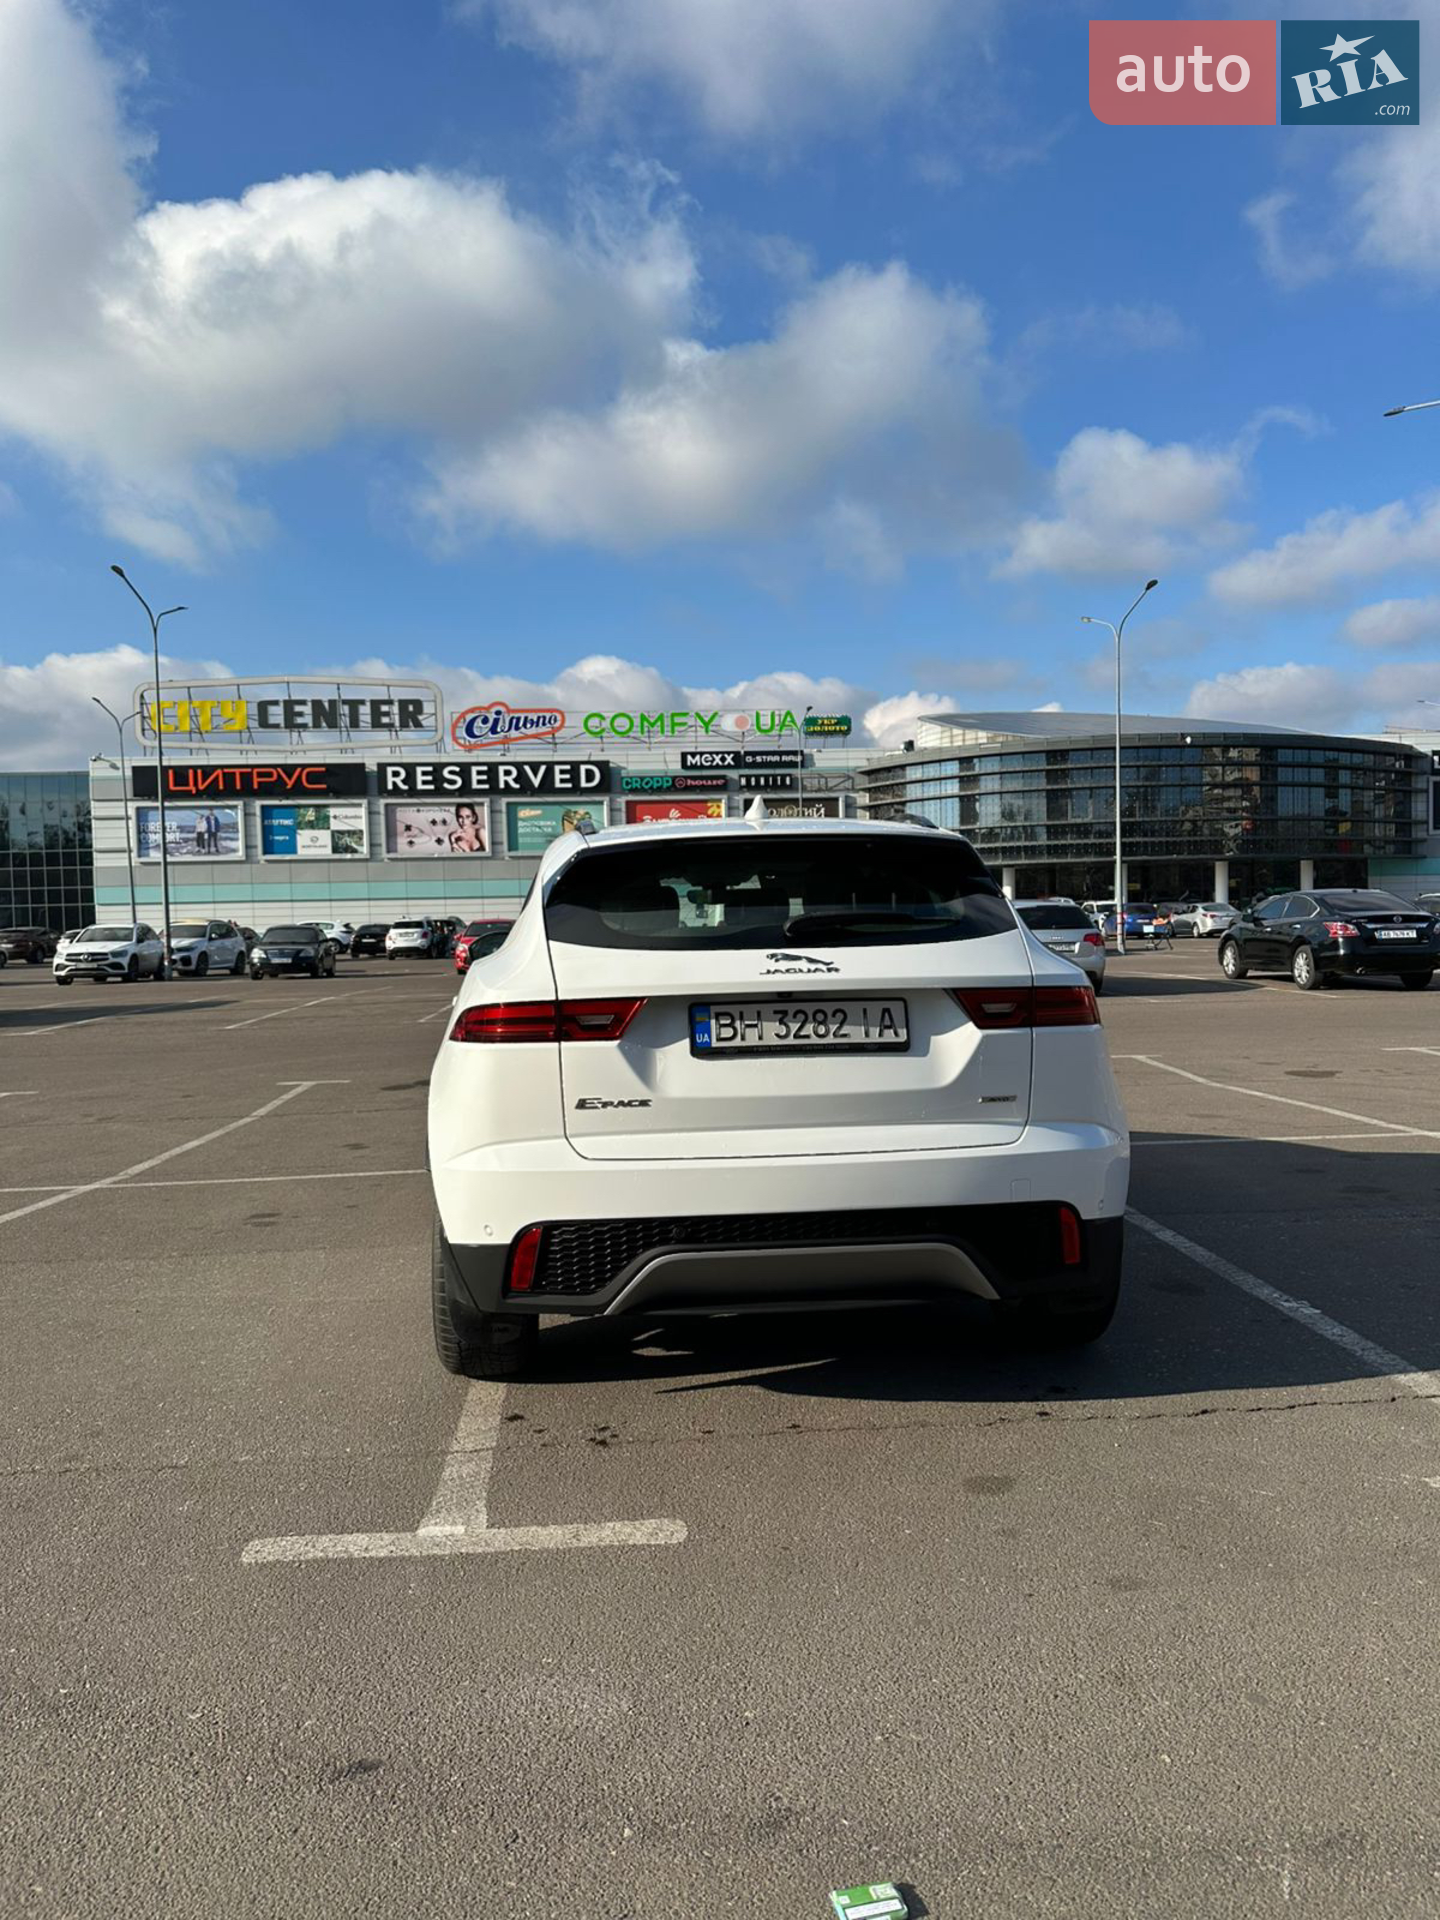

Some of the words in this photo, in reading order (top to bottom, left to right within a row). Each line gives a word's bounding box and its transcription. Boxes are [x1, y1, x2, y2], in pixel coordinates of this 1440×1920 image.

[149, 699, 248, 733] CITY
[256, 698, 424, 729] CENTER
[464, 709, 558, 740] Сільпо
[583, 710, 719, 737] COMFY
[755, 710, 799, 734] UA
[745, 755, 780, 763] G-STAR
[781, 754, 803, 762] RAW
[168, 767, 327, 794] ЦИТРУС
[386, 764, 602, 790] RESERVED
[622, 777, 672, 789] CROPP
[139, 821, 180, 833] FOREER.
[140, 832, 183, 843] COMORT.
[759, 966, 841, 975] JAGUAR
[714, 1009, 764, 1042] BH
[772, 1008, 850, 1040] 3282
[862, 1006, 900, 1038] IA
[696, 1033, 710, 1043] UA
